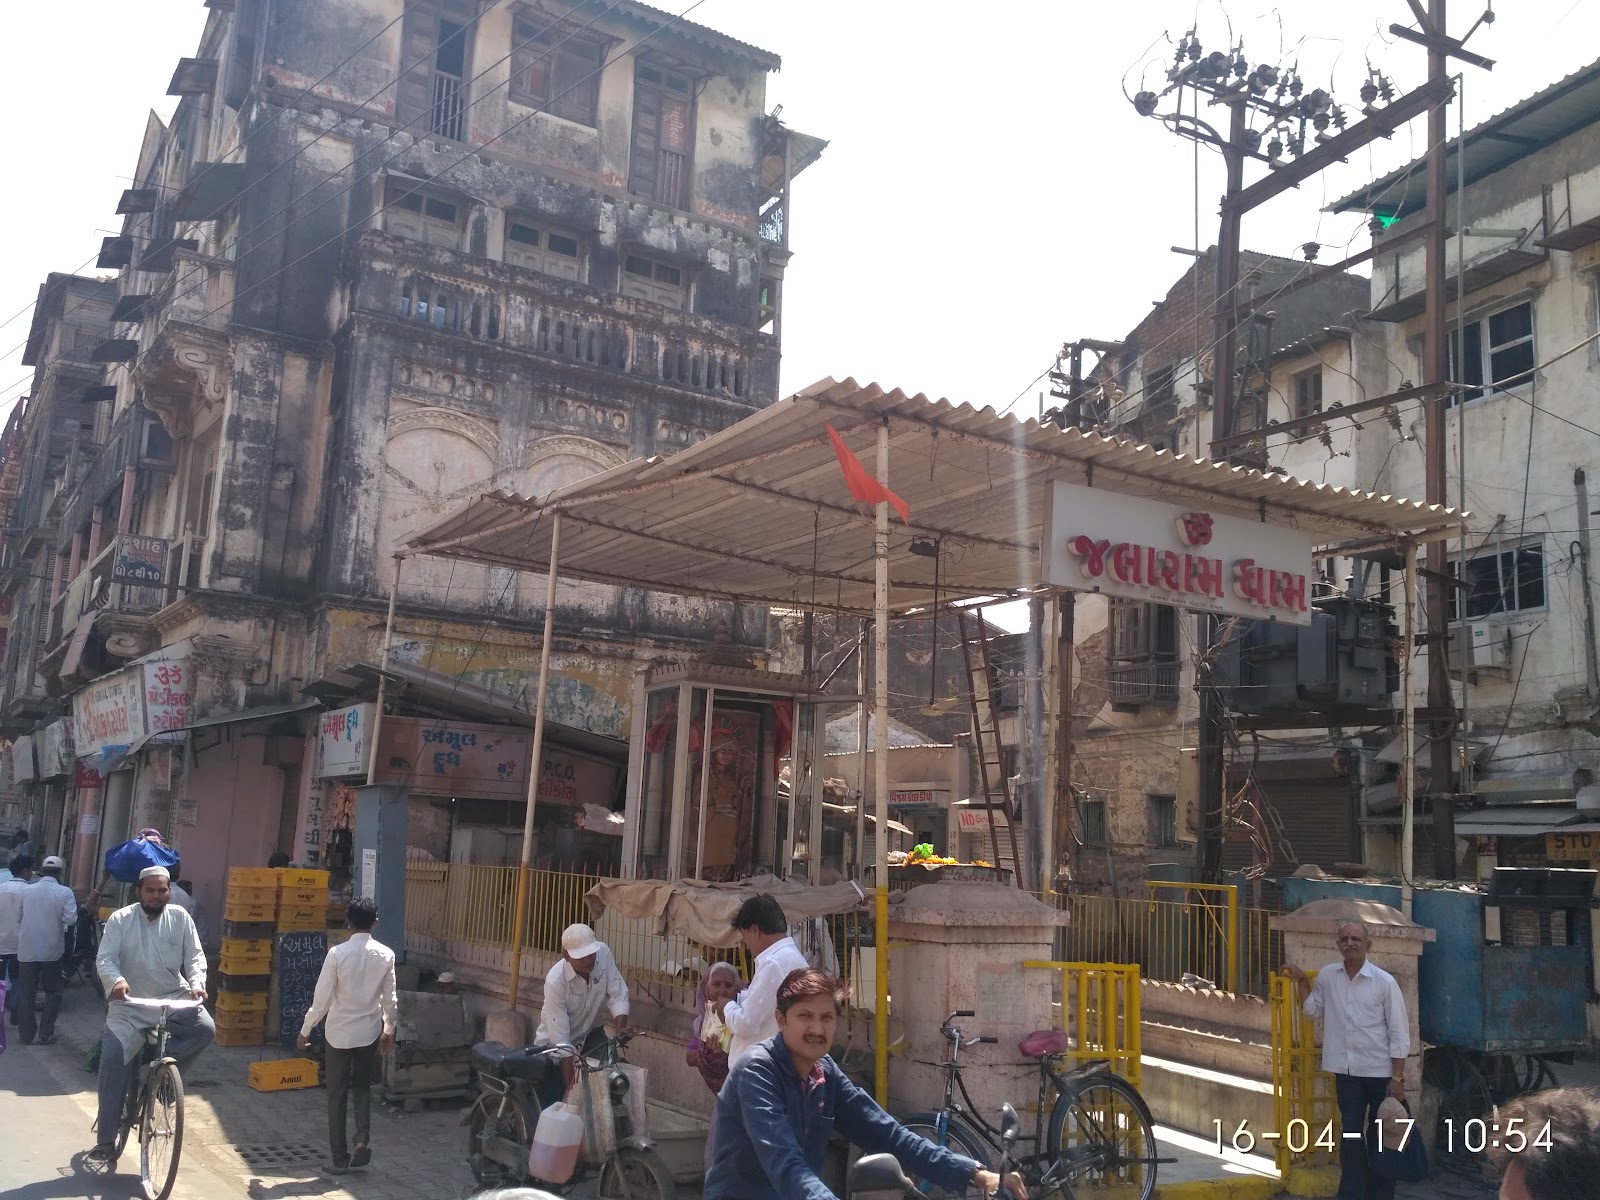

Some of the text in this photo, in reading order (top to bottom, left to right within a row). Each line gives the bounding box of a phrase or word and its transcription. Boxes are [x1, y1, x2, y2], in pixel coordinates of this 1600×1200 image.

[1067, 534, 1225, 599] જલારામ
[1553, 833, 1592, 849] STD
[280, 1075, 302, 1084] Amul
